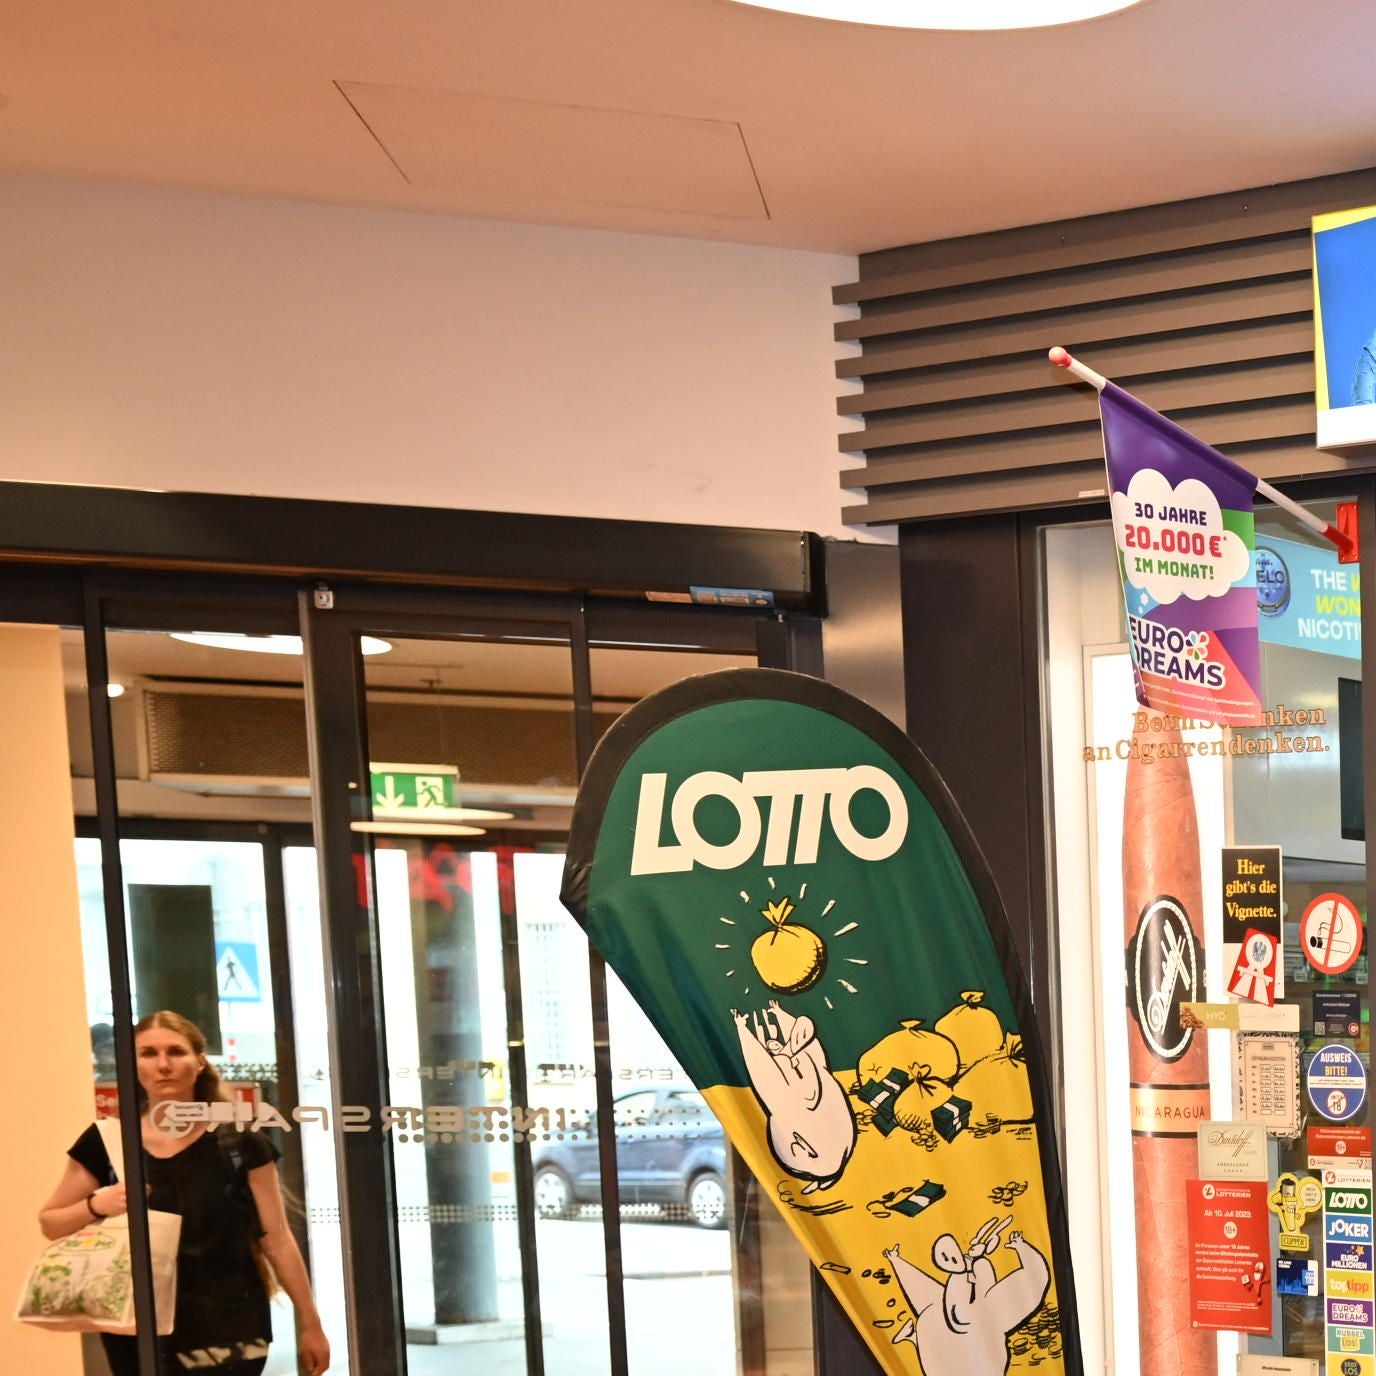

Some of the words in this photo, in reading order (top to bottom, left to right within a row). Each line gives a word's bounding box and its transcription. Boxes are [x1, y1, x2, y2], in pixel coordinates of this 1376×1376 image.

[1135, 502, 1153, 519] 30
[1158, 503, 1207, 527] JAHRE
[1124, 523, 1205, 556] 20.000
[1134, 557, 1154, 573] IM
[1157, 559, 1214, 580] MONAT!
[1310, 569, 1348, 592] THE
[1115, 733, 1227, 767] Cigarren
[1229, 731, 1332, 758] denken.
[630, 764, 909, 876] LOTTO
[1237, 858, 1266, 875] Hier
[1225, 880, 1257, 898] gibt's
[1259, 879, 1277, 894] die
[1226, 901, 1277, 922] Vignette.
[1320, 1052, 1352, 1064] AUSWEIS
[1324, 1065, 1348, 1076] BITTE!
[1329, 1191, 1368, 1209] LOTTO
[1328, 1218, 1369, 1238] JOKER
[1331, 1260, 1368, 1270] MILLIONEN
[1340, 1253, 1359, 1262] EURO
[1332, 1304, 1356, 1313] EURO
[1332, 1312, 1368, 1322] DREAMS
